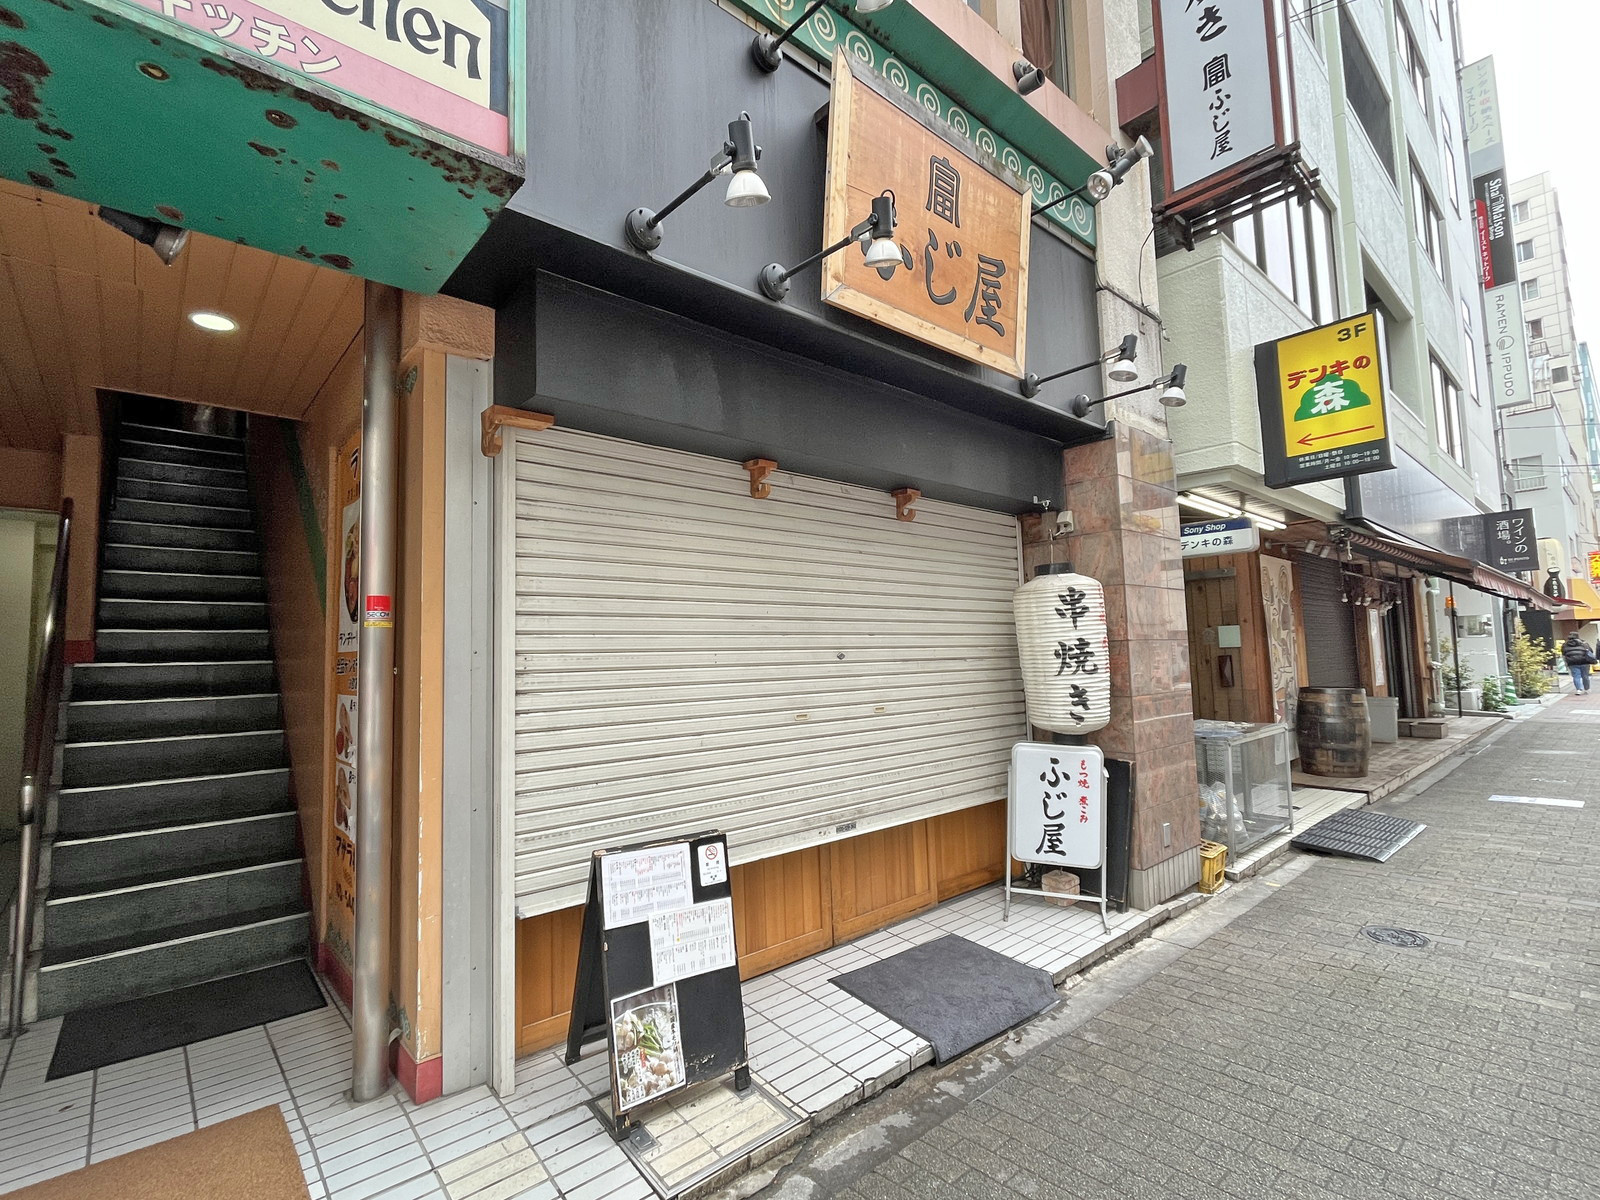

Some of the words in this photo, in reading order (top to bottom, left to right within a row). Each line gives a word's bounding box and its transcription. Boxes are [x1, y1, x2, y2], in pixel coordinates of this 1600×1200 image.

[925, 155, 960, 229] 富
[1337, 322, 1367, 342] 3F
[1495, 294, 1508, 335] RAMEN
[1287, 355, 1371, 390] デンキの
[1500, 352, 1515, 397] IPPUDO
[1310, 380, 1350, 415] 森
[1181, 536, 1233, 551] デンキの森
[1184, 525, 1203, 535] Sony
[1205, 522, 1226, 533] Shop
[1512, 518, 1528, 554] ワインの
[1054, 586, 1099, 726] 串焼き
[1036, 757, 1071, 857] ふじ屋
